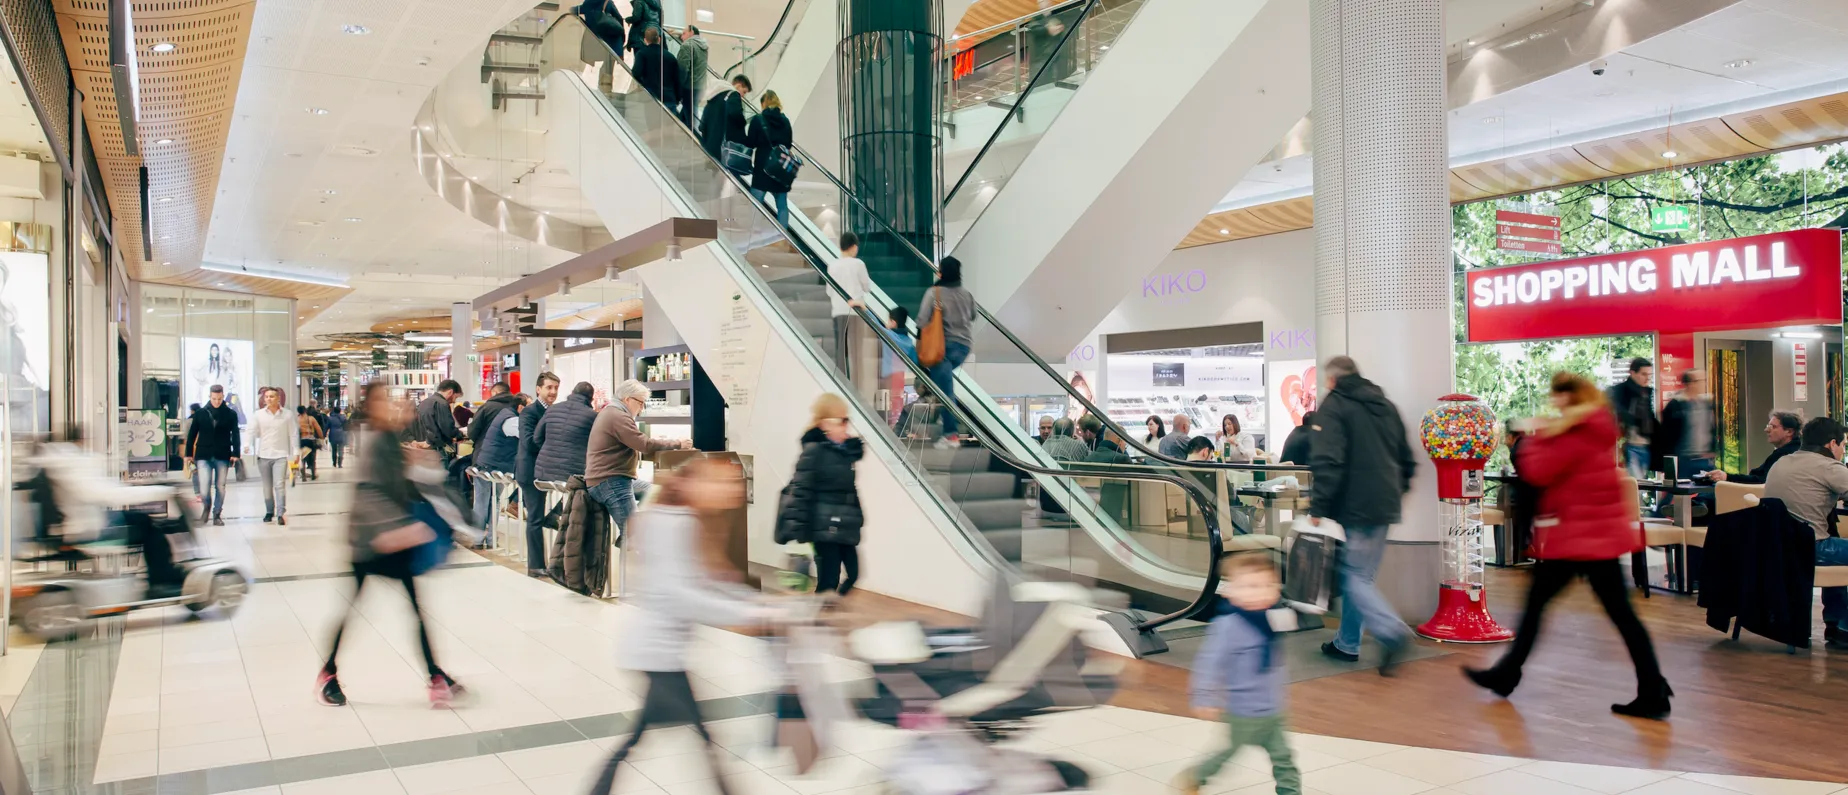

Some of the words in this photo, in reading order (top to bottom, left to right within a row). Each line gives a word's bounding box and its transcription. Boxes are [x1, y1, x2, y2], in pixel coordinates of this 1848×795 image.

[1500, 225, 1510, 235] Lift
[1501, 239, 1525, 249] Toiletten
[1473, 258, 1657, 308] SHOPPING
[1671, 241, 1800, 288] MALL
[1143, 269, 1207, 298] KIKO
[1270, 328, 1316, 349] KIK
[1070, 344, 1095, 361] KO
[1661, 353, 1673, 364] WC
[127, 430, 135, 443] 3
[145, 430, 156, 443] 2
